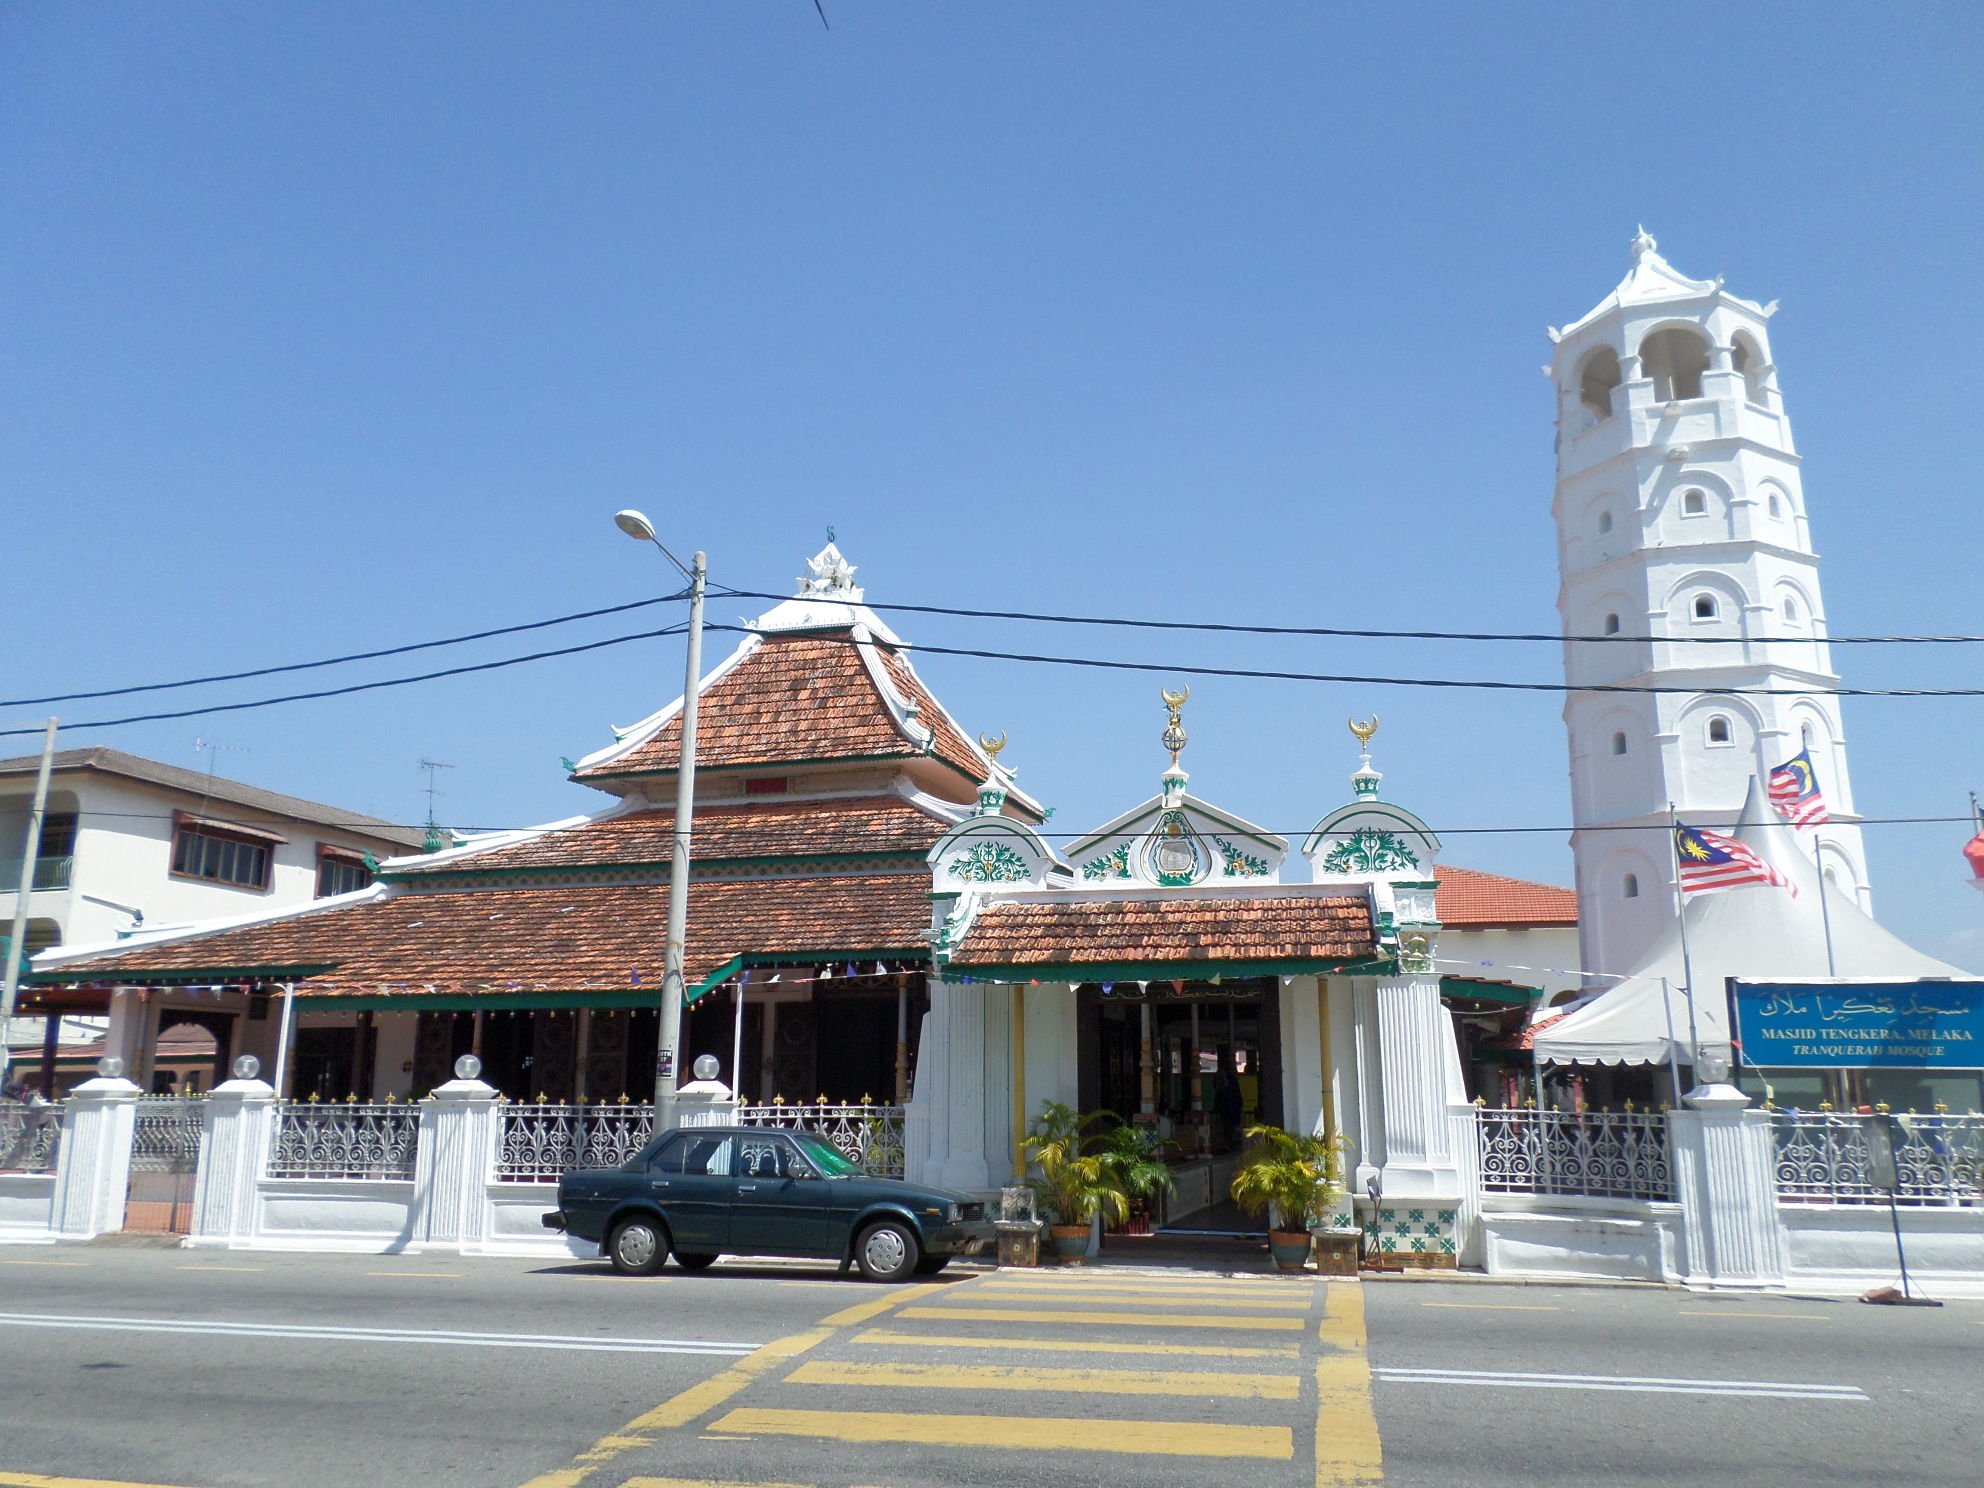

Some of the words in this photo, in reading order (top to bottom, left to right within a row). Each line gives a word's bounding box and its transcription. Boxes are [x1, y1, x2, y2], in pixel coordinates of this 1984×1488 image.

[1761, 1029, 1817, 1039] MASJID
[1819, 1029, 1905, 1041] TENGKERA,
[1908, 1029, 1973, 1040] MELAKA
[1792, 1045, 1883, 1056] TRANQUERAH
[1887, 1045, 1945, 1057] MOSQUE
